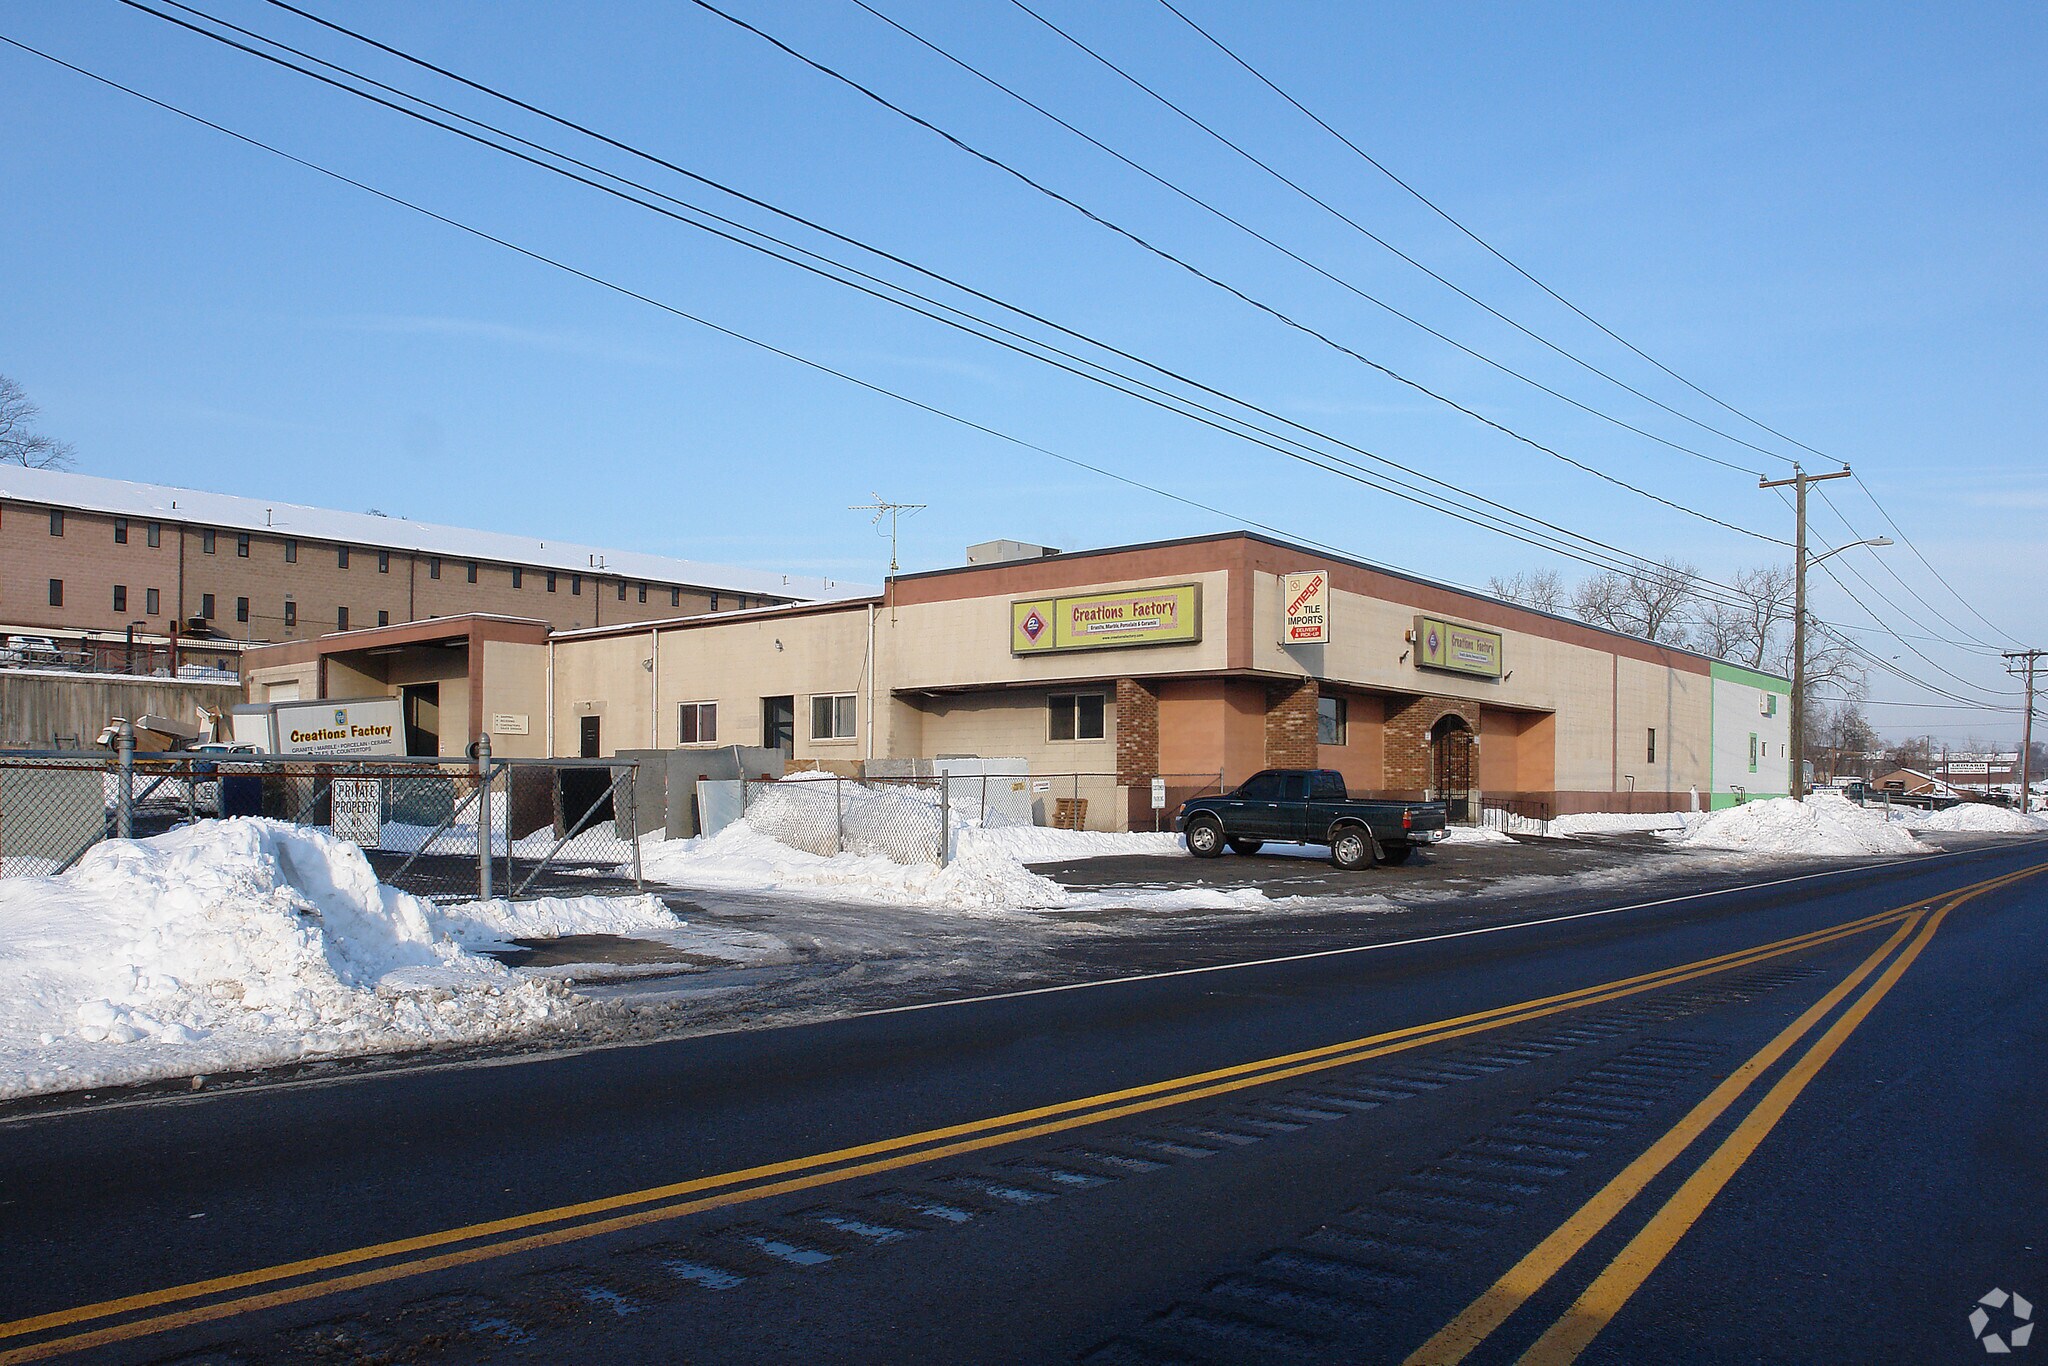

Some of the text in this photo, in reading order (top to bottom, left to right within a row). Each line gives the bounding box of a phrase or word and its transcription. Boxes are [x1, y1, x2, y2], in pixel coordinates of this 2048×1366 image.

[1073, 601, 1175, 622] Creations Factory
[1304, 605, 1320, 614] TILE
[1288, 615, 1323, 625] IMPORTS
[1452, 634, 1473, 650] Creations
[1477, 639, 1494, 656] Factory
[290, 725, 392, 743] Creations Factory
[336, 746, 372, 754] COUNTERTOPS
[338, 785, 376, 798] PRIVATE
[336, 801, 378, 814] PROPERTY
